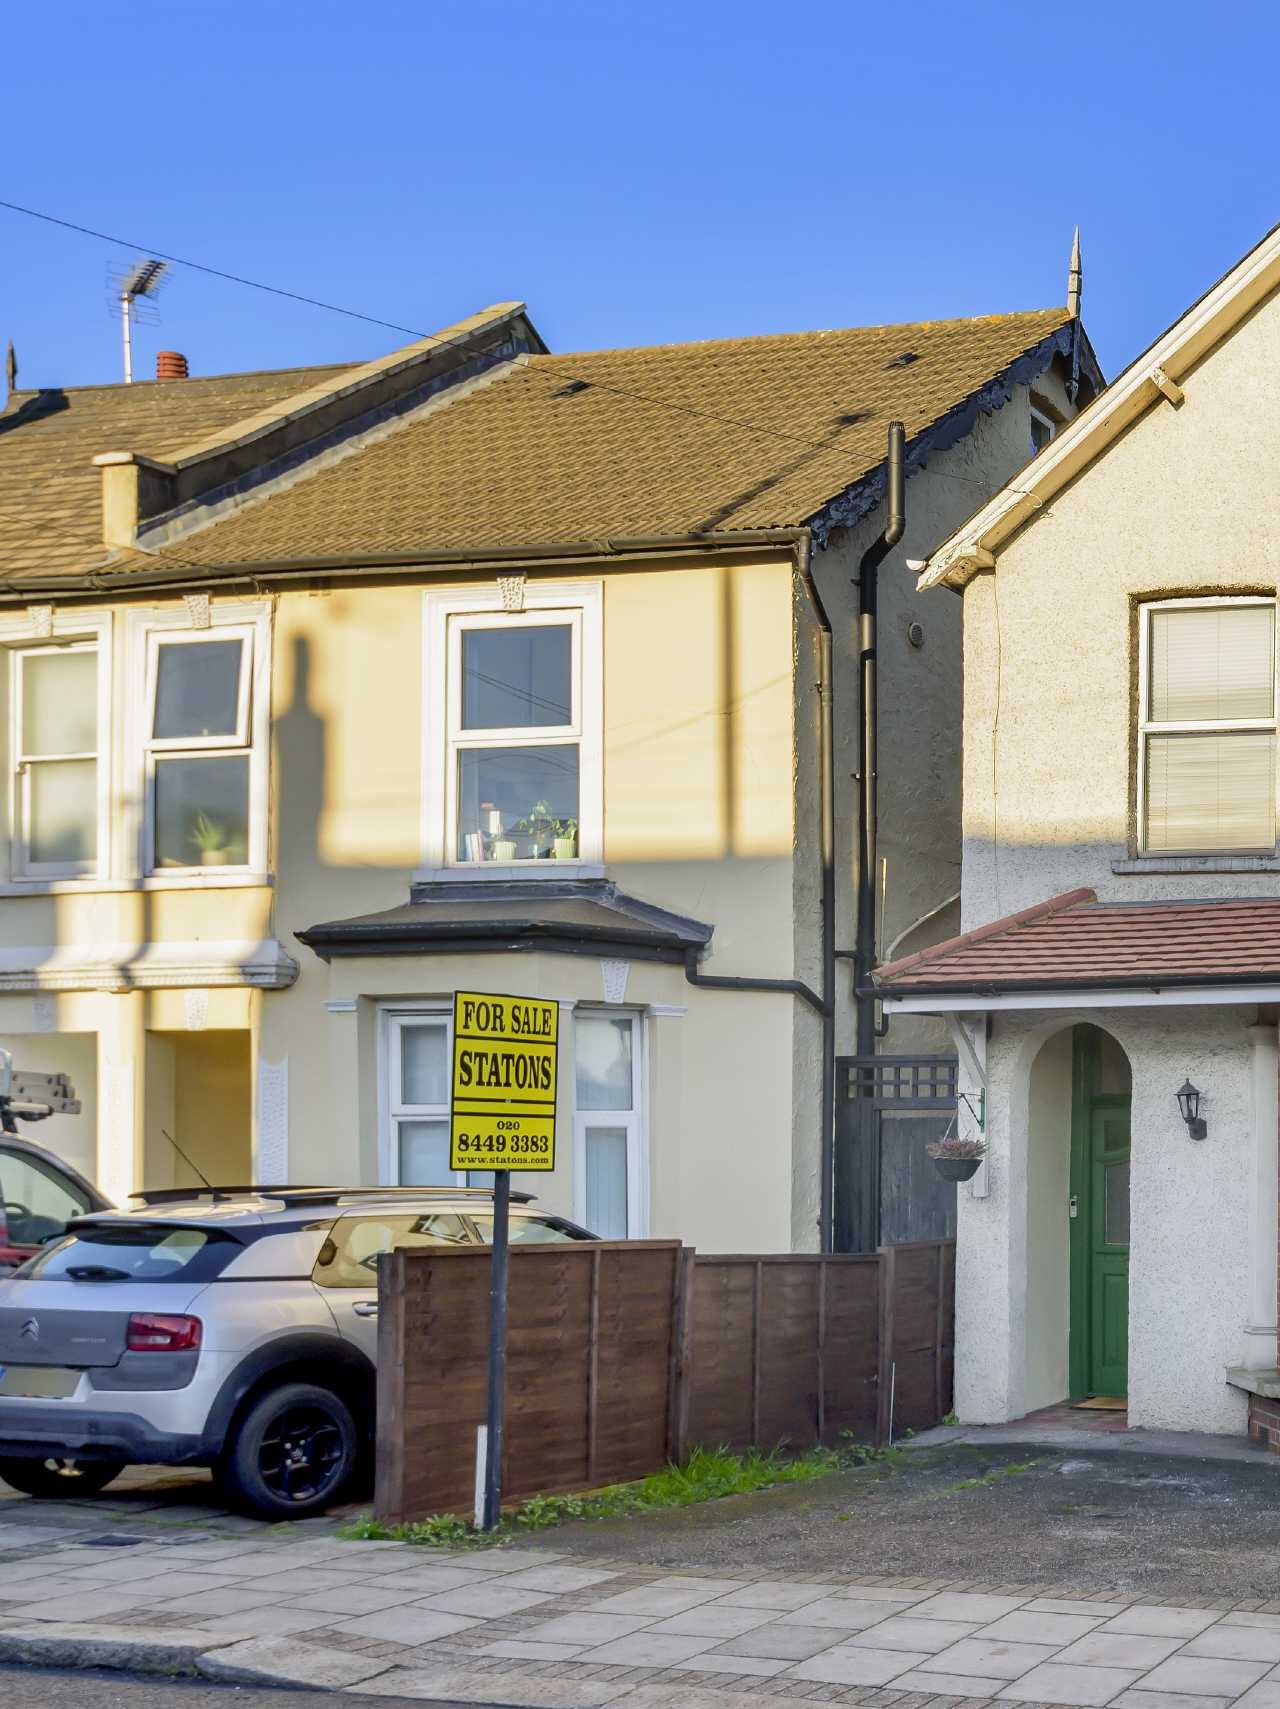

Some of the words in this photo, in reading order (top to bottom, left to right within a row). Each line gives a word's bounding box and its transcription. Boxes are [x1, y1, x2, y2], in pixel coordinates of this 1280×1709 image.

[463, 1001, 505, 1033] FOR
[511, 1004, 552, 1036] SALE
[459, 1050, 552, 1090] STATONS
[496, 1120, 520, 1130] 020
[457, 1133, 507, 1153] 8449
[510, 1135, 549, 1153] 3383
[457, 1156, 549, 1165] www.statons.com
